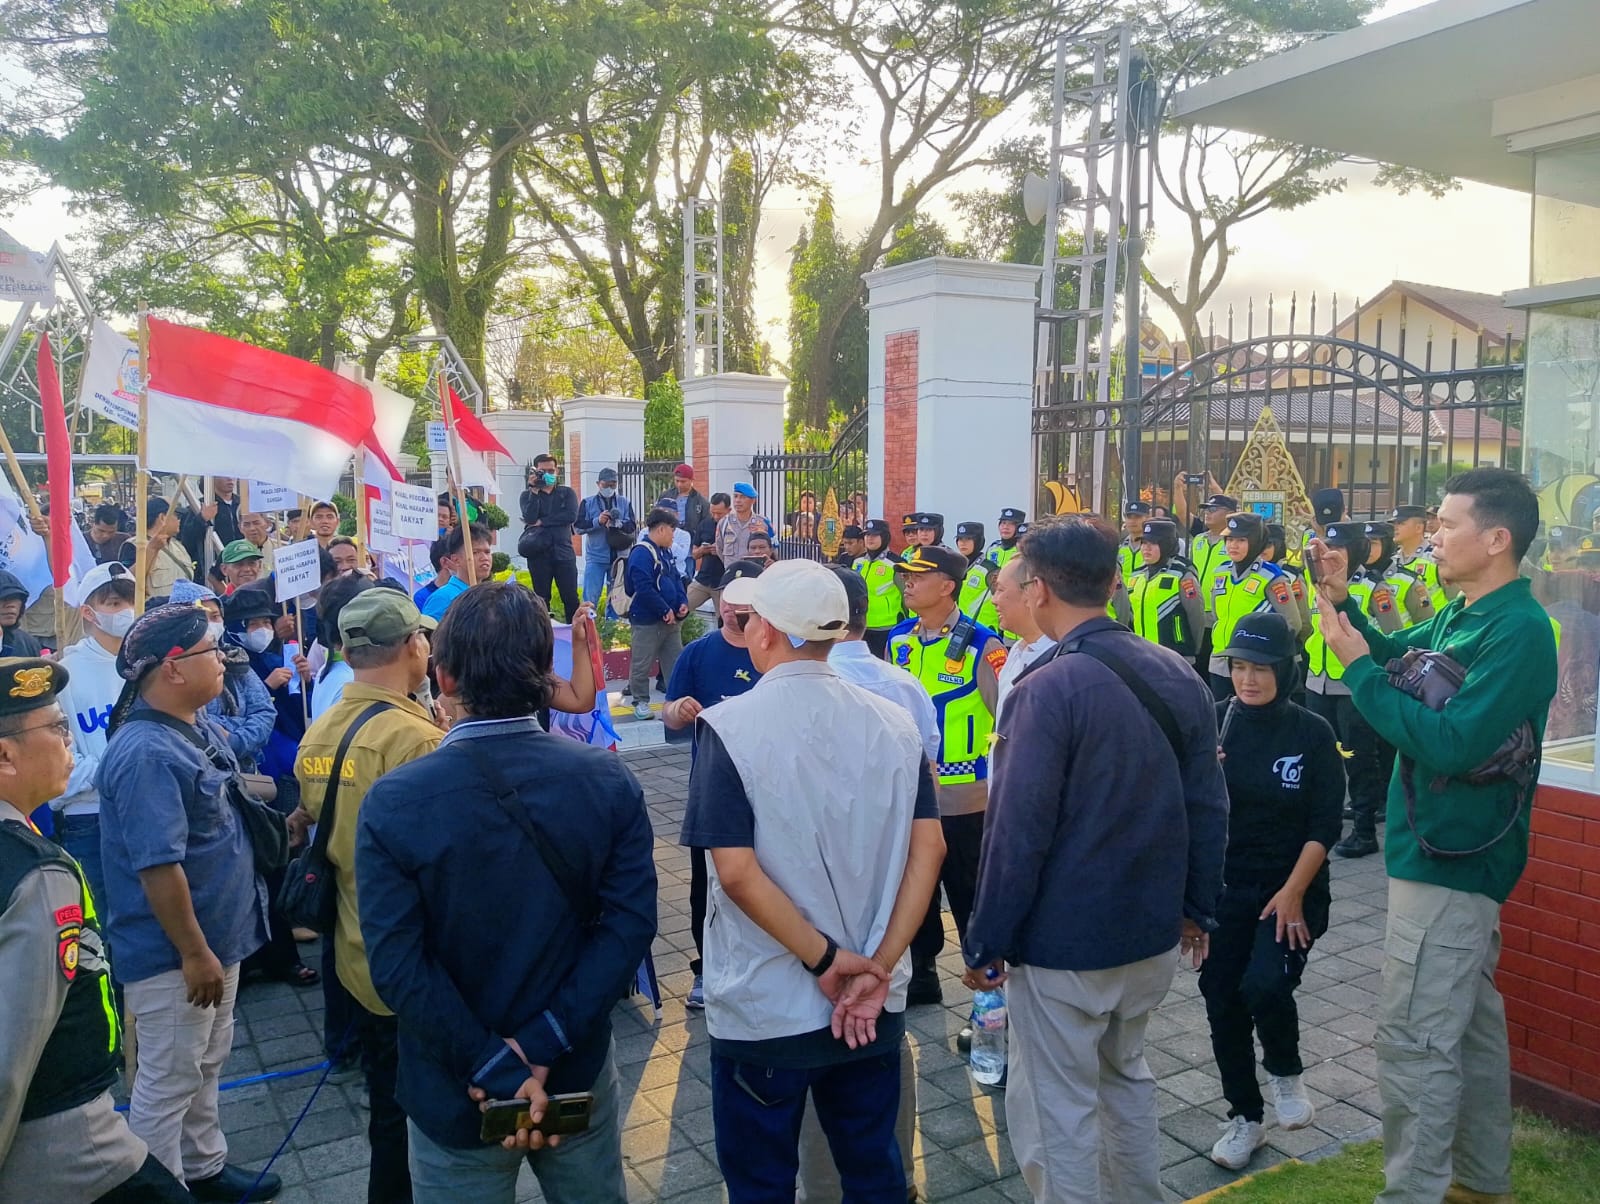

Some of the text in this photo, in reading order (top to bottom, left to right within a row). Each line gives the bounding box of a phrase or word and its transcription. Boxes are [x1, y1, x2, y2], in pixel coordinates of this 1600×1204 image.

[409, 494, 434, 503] PROGRAM
[1243, 491, 1284, 502] KEBUMEN
[409, 505, 434, 514] HARAPAN
[401, 515, 424, 525] RAKYAT
[295, 549, 315, 559] PROGRAM
[296, 559, 316, 568] HARAPAN
[288, 572, 309, 583] RAKYAT
[939, 674, 963, 683] POLRI
[303, 757, 355, 778] SATS
